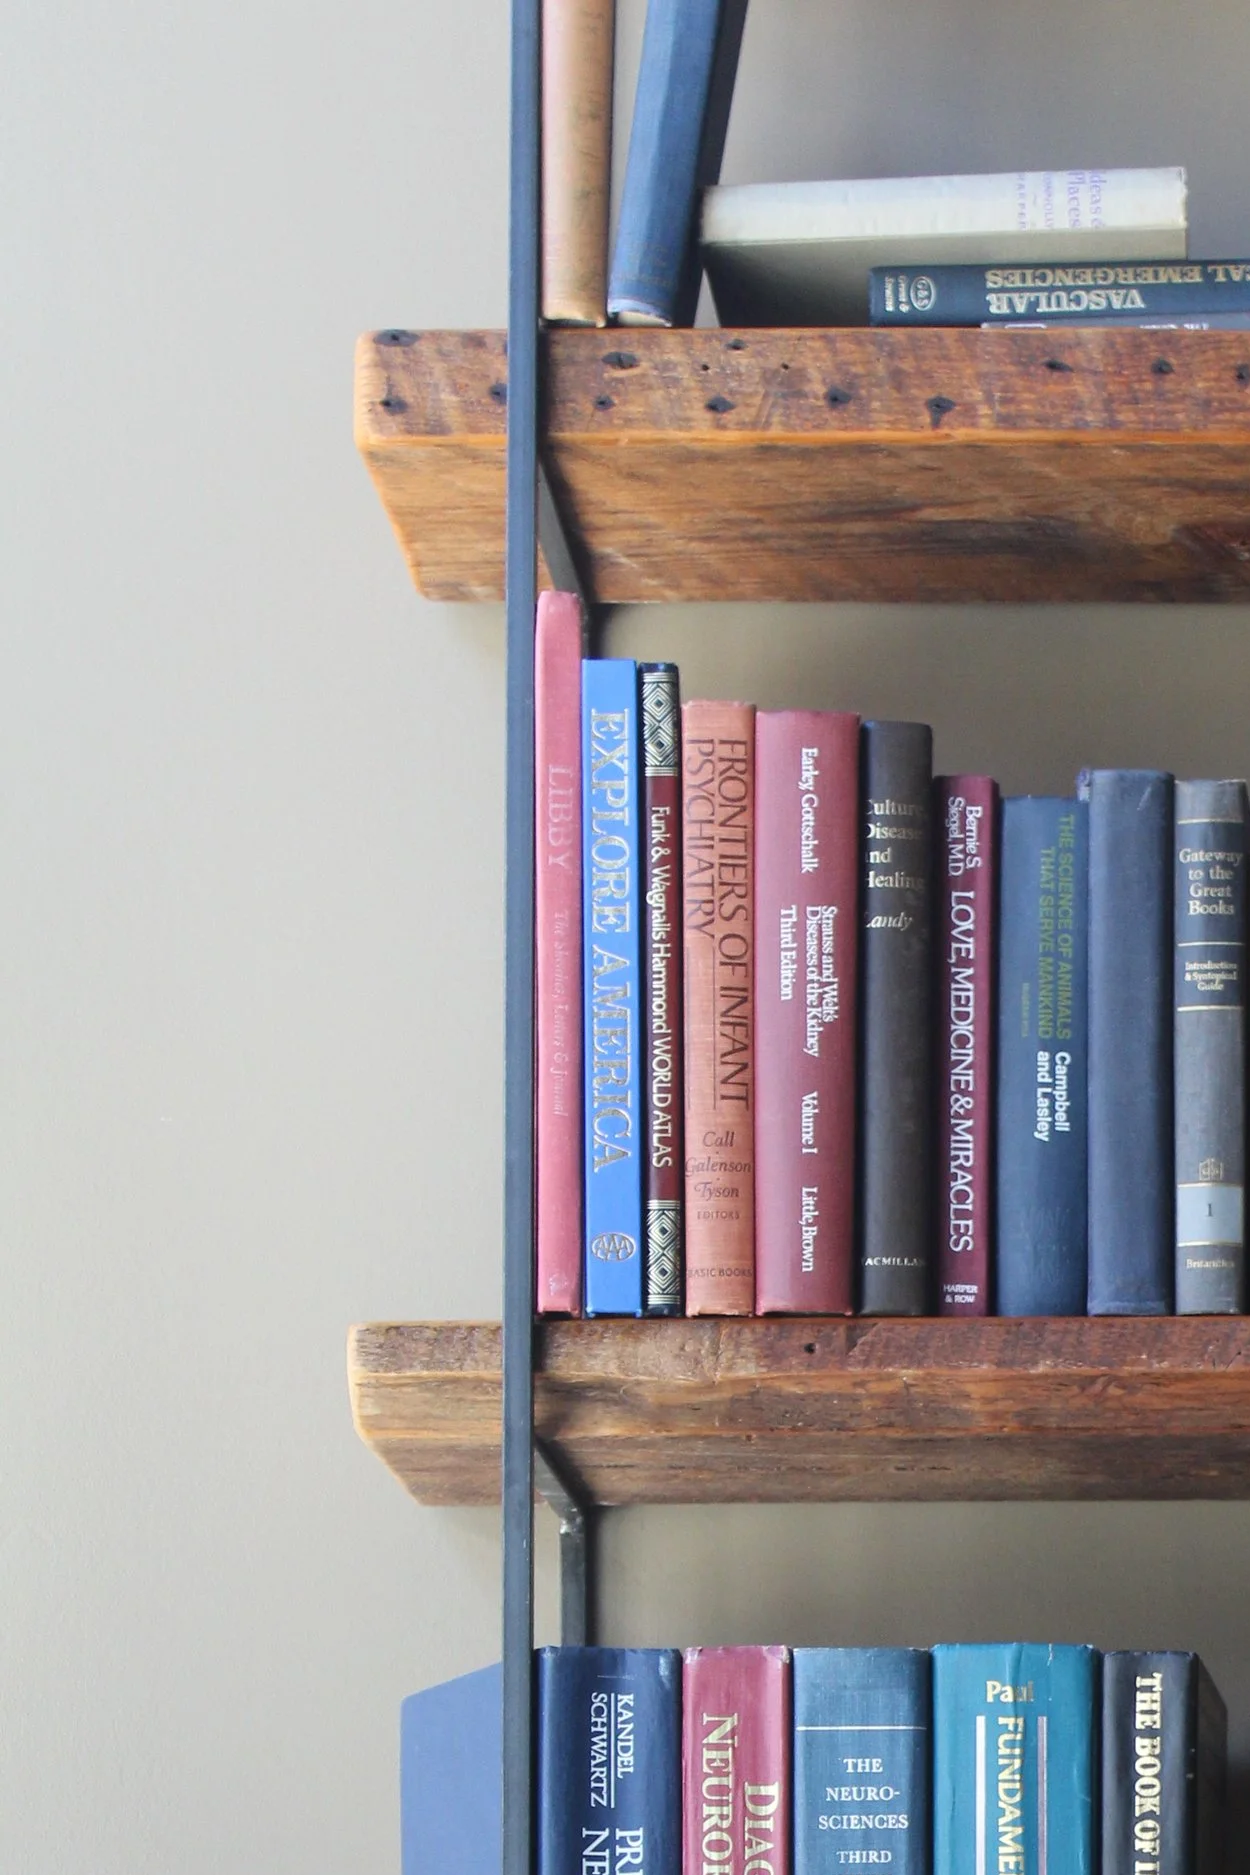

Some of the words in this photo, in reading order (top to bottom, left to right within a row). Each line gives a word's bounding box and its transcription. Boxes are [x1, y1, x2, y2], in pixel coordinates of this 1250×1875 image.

[1067, 172, 1086, 229] Places
[984, 266, 1203, 289] EMERGENCIES
[986, 288, 1145, 315] VASCULAR
[798, 747, 820, 791] Earley,
[548, 765, 571, 871] LIBBY
[591, 708, 630, 934] EXPLORE
[651, 806, 671, 844] Funk
[685, 738, 715, 939] PSYCHIATRY
[718, 739, 749, 923] FRONTIERS
[800, 793, 819, 874] Gottschalk
[944, 796, 965, 842] Siegel,
[965, 805, 984, 854] Bernie
[1057, 815, 1075, 849] THE
[651, 846, 670, 863] &
[947, 844, 965, 877] M.D.
[964, 856, 983, 870] S.
[1039, 848, 1057, 892] THAT
[1179, 848, 1244, 866] Gateway
[1188, 867, 1204, 881] to
[1209, 867, 1234, 881] the
[646, 864, 671, 941] Wagnalls
[1057, 852, 1075, 931] SCIENCE
[1187, 899, 1236, 916] Books
[1189, 882, 1233, 898] Great
[554, 910, 569, 937] The
[780, 904, 798, 948] Third
[805, 905, 823, 965] Diseases
[821, 905, 838, 954] Strauss
[946, 891, 976, 964] LOVE,
[1038, 894, 1056, 954] SERVE
[718, 933, 749, 978] OF
[1056, 933, 1073, 959] OF
[651, 942, 672, 1034] Hammond
[779, 949, 797, 1001] Edition
[805, 966, 822, 983] of
[821, 955, 839, 982] and
[1197, 981, 1224, 992] Guide
[805, 983, 821, 1005] the
[822, 984, 840, 1023] Welt's
[1037, 956, 1055, 1039] MANKIND
[1055, 961, 1073, 1041] ANIMALS
[718, 985, 749, 1111] INFANT
[802, 1007, 821, 1058] Kidney
[949, 966, 976, 1092] MEDICINE
[592, 943, 632, 1173] AMERICA
[652, 1036, 672, 1106] WORLD
[1037, 1051, 1054, 1083] and
[949, 1093, 975, 1117] &
[1052, 1052, 1072, 1132] Campbell
[801, 1091, 818, 1145] Volume
[1034, 1087, 1053, 1142] Lasley
[652, 1109, 672, 1168] ATLAS
[703, 1130, 735, 1148] Call
[685, 1155, 752, 1178] Galenson
[949, 1118, 975, 1253] MIRACLES
[694, 1180, 740, 1202] Tyson
[798, 1186, 818, 1225] Little,
[697, 1210, 740, 1221] EDITORS
[592, 1234, 634, 1261] AAA
[801, 1226, 818, 1273] Brown
[687, 1266, 716, 1278] BASIC
[718, 1266, 754, 1278] BOOKS
[943, 1284, 978, 1294] HARPER
[945, 1294, 953, 1304] &
[954, 1294, 977, 1303] ROW
[985, 1680, 1035, 1703] Paul
[1135, 1673, 1162, 1729] THE
[590, 1692, 607, 1808] SCHWARTZ
[616, 1693, 635, 1779] KANDEL
[842, 1758, 884, 1774] THE
[1134, 1736, 1161, 1818] BOOK
[825, 1785, 901, 1802] NEURO-
[817, 1814, 909, 1831] SCIENCES
[1134, 1820, 1160, 1856] OF
[836, 1850, 892, 1865] THIRD
